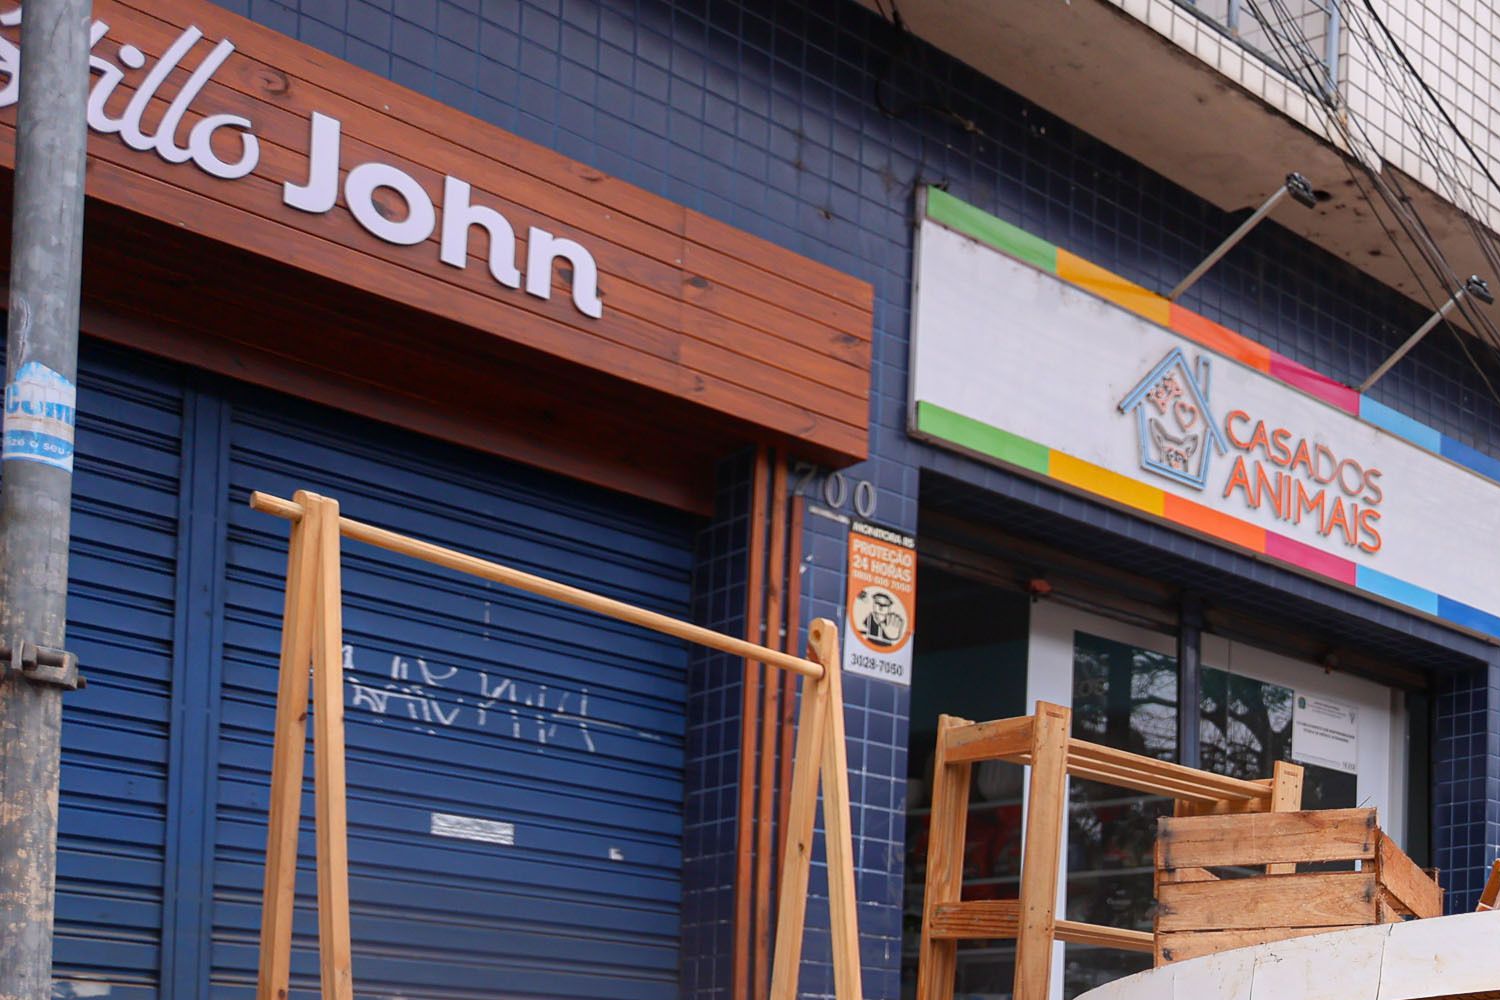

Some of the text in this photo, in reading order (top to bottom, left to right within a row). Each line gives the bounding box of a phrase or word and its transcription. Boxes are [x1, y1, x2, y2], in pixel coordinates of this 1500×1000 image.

[283, 111, 603, 318] John
[1223, 455, 1383, 553] ANIMAIS
[852, 555, 912, 582] 24 HORAS
